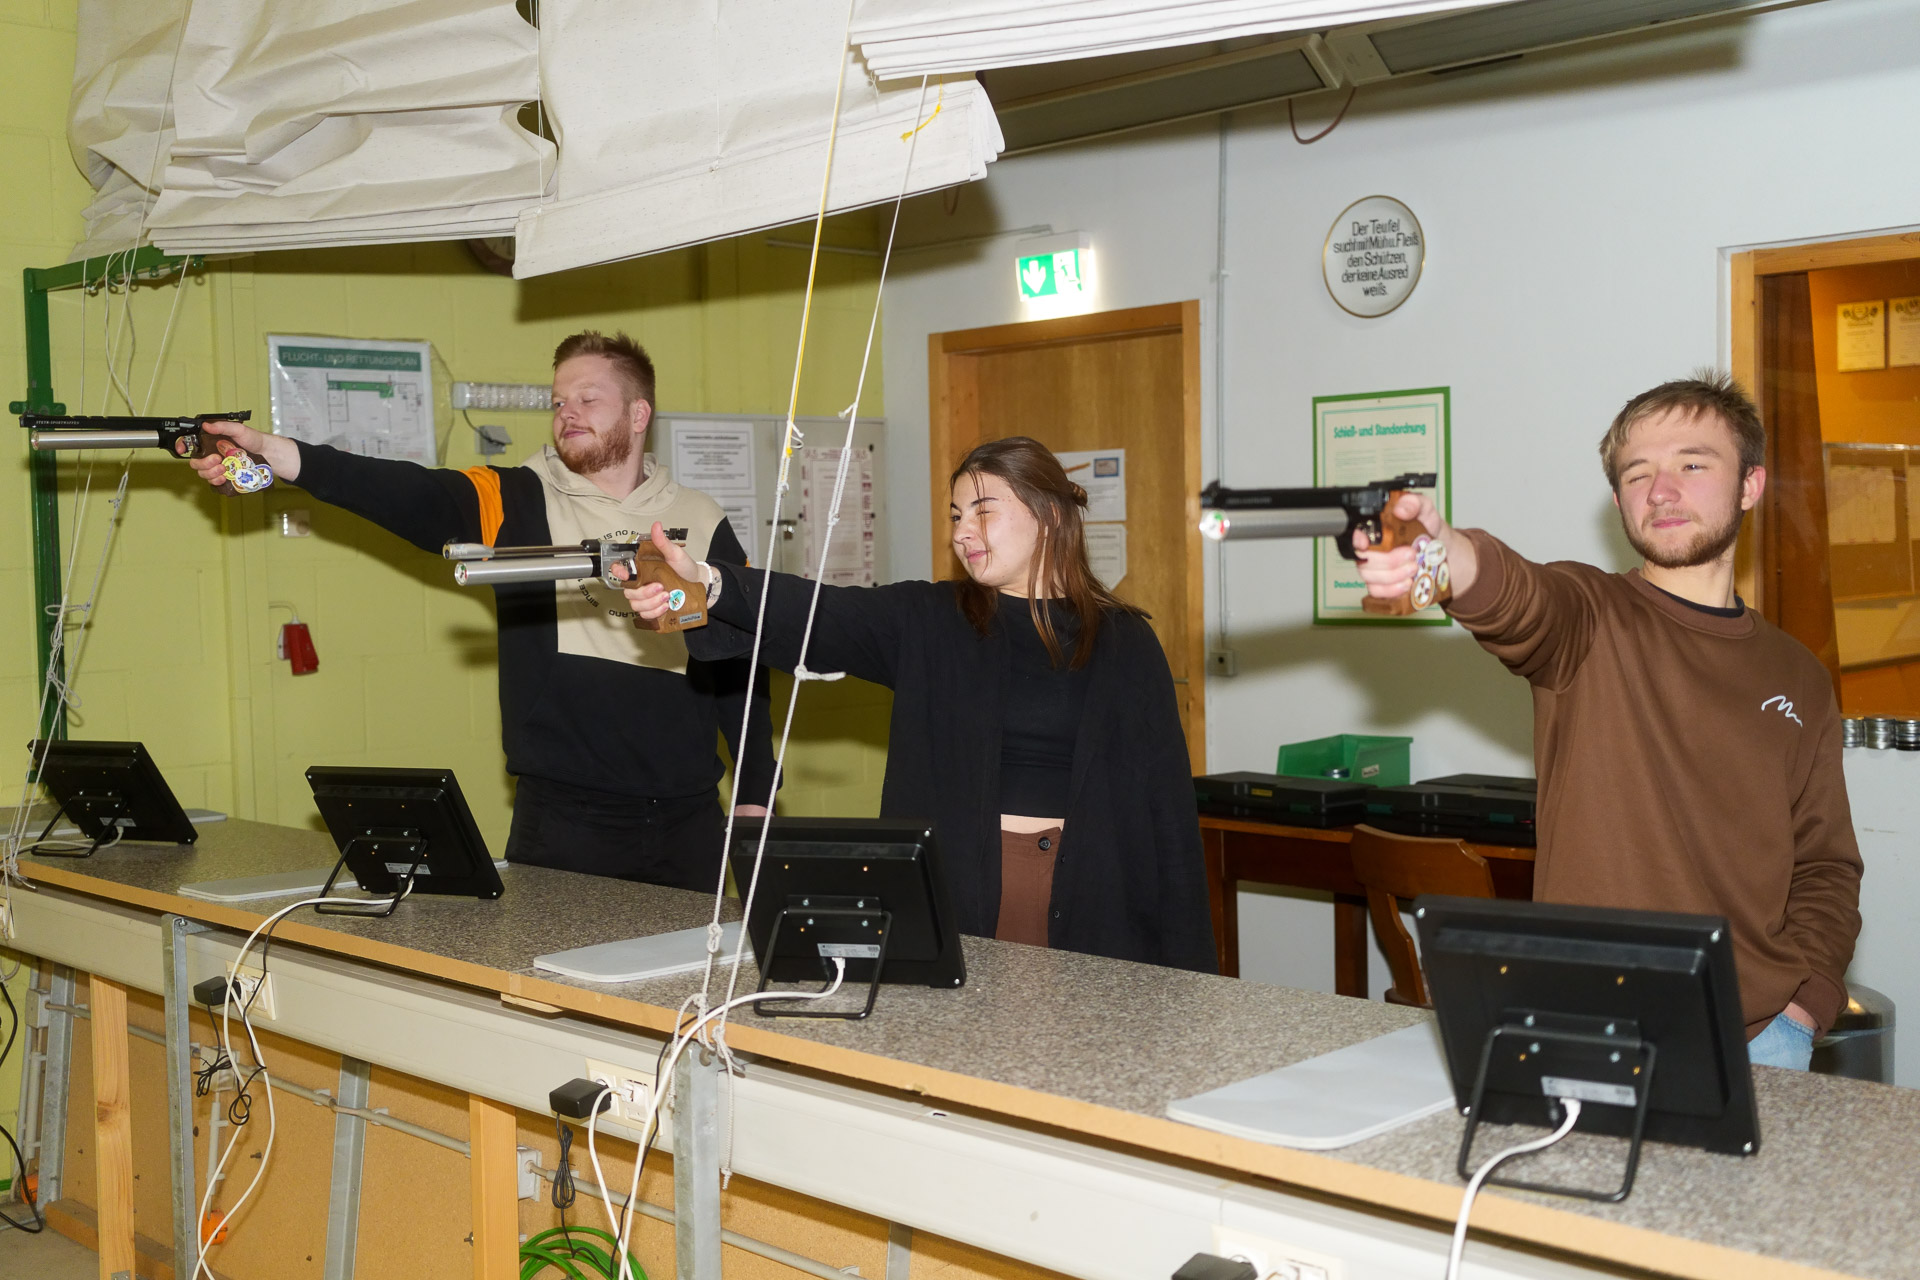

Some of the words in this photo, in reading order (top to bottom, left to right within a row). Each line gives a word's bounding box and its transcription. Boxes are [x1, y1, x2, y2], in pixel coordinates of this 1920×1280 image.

[1352, 221, 1368, 236] Der
[1369, 219, 1400, 234] Teufel
[1347, 254, 1363, 268] den
[282, 352, 321, 362] FLUCHT-
[323, 353, 343, 364] UND
[345, 355, 417, 366] RETTUNGSPLAN
[1359, 424, 1373, 436] und
[1375, 422, 1426, 435] Standordnung
[579, 584, 600, 607] SINCE
